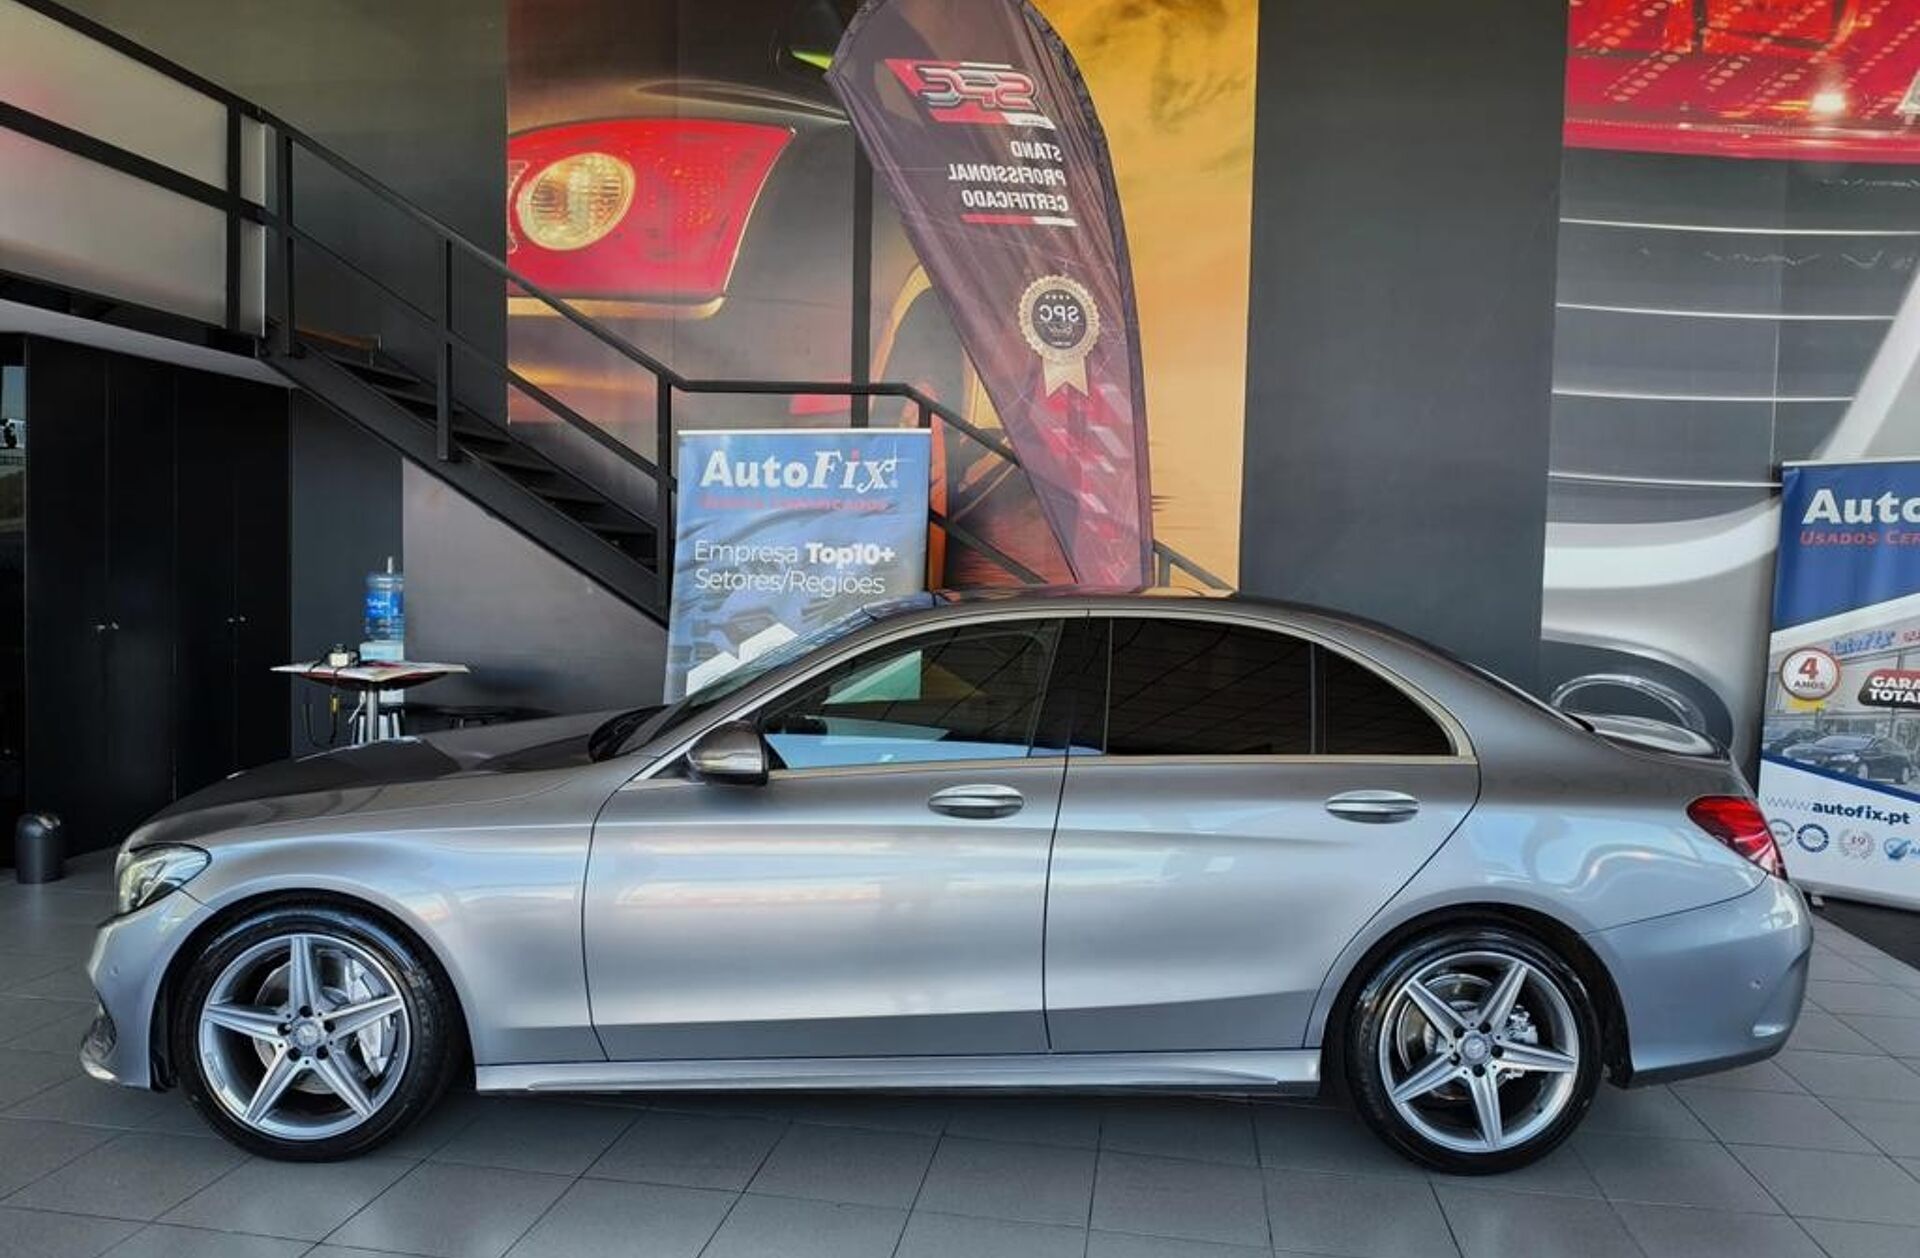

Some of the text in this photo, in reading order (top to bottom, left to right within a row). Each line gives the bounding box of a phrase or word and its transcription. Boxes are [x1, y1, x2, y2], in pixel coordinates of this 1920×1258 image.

[701, 448, 899, 493] AutoFix
[695, 540, 896, 570] Empresa Top10+
[695, 567, 886, 597] Setores/Regiões
[1798, 657, 1819, 679] 4
[1869, 688, 1920, 703] TOTA
